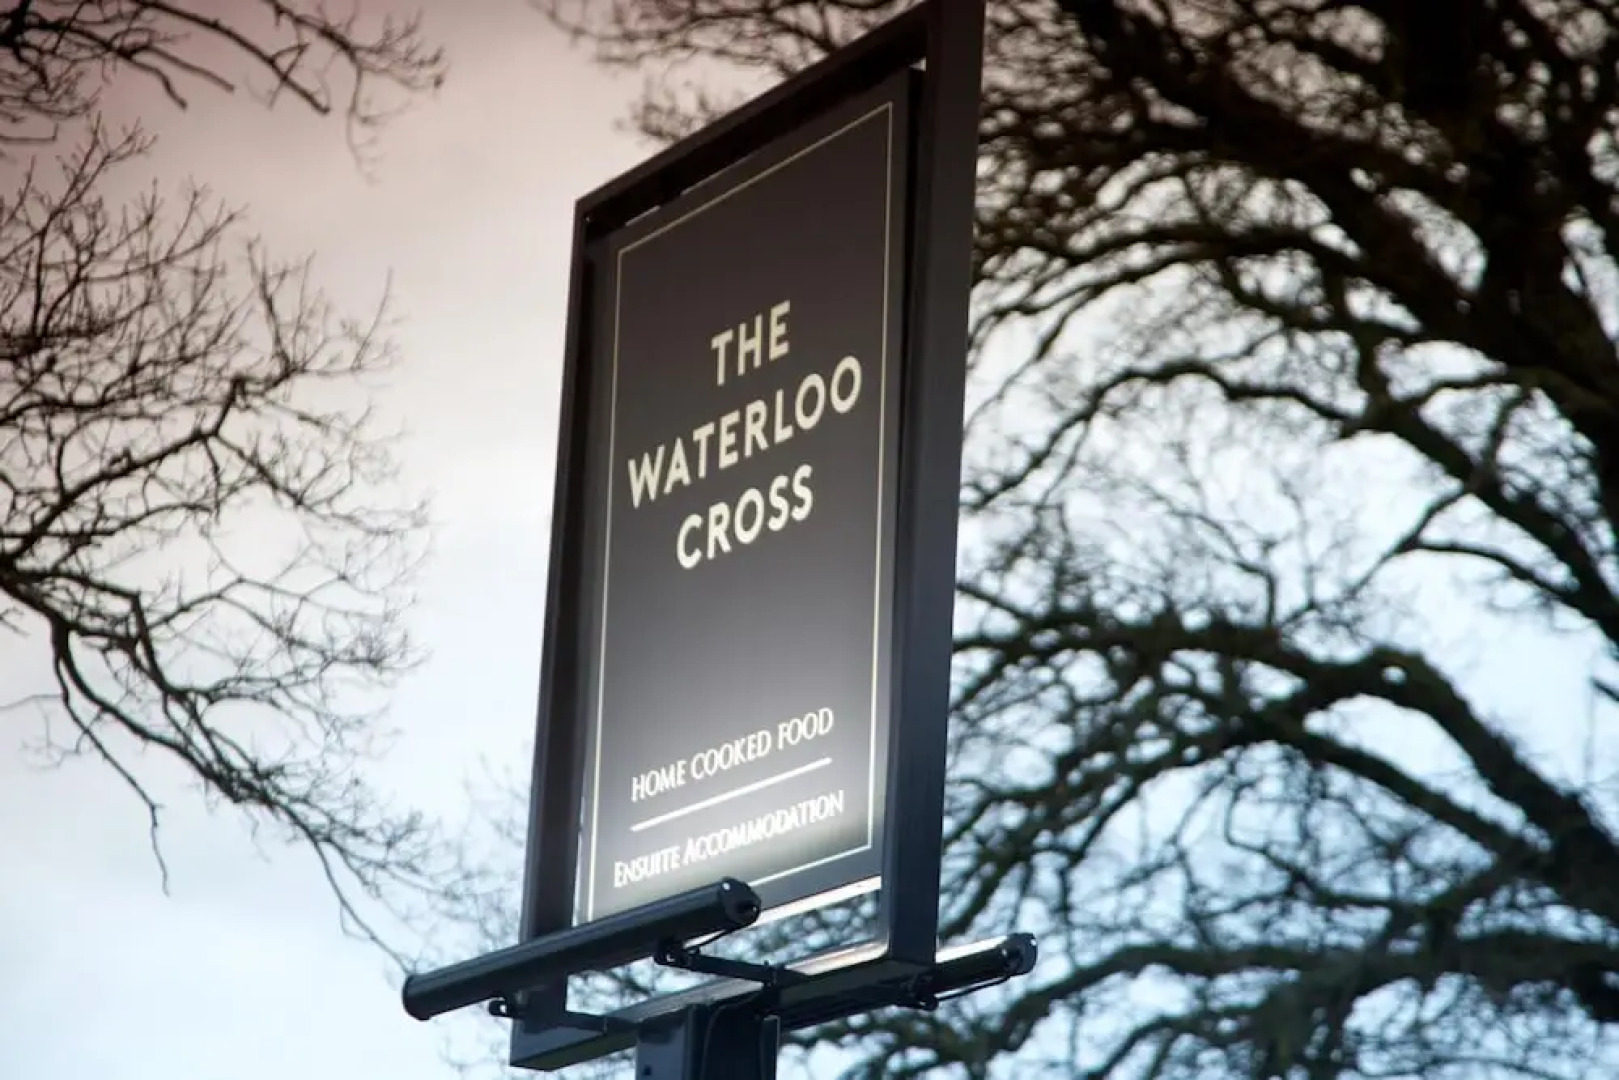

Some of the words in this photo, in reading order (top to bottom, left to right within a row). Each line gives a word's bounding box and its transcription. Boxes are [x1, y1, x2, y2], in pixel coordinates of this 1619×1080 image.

[711, 300, 790, 386] THE
[628, 355, 862, 508] WATERLOO
[677, 464, 813, 569] CROSS
[631, 760, 687, 802] HOME
[691, 729, 771, 780] COOKED
[777, 707, 833, 750] FOOD
[613, 846, 680, 887] ENSUITE
[683, 790, 844, 865] ACCOMMODATION
